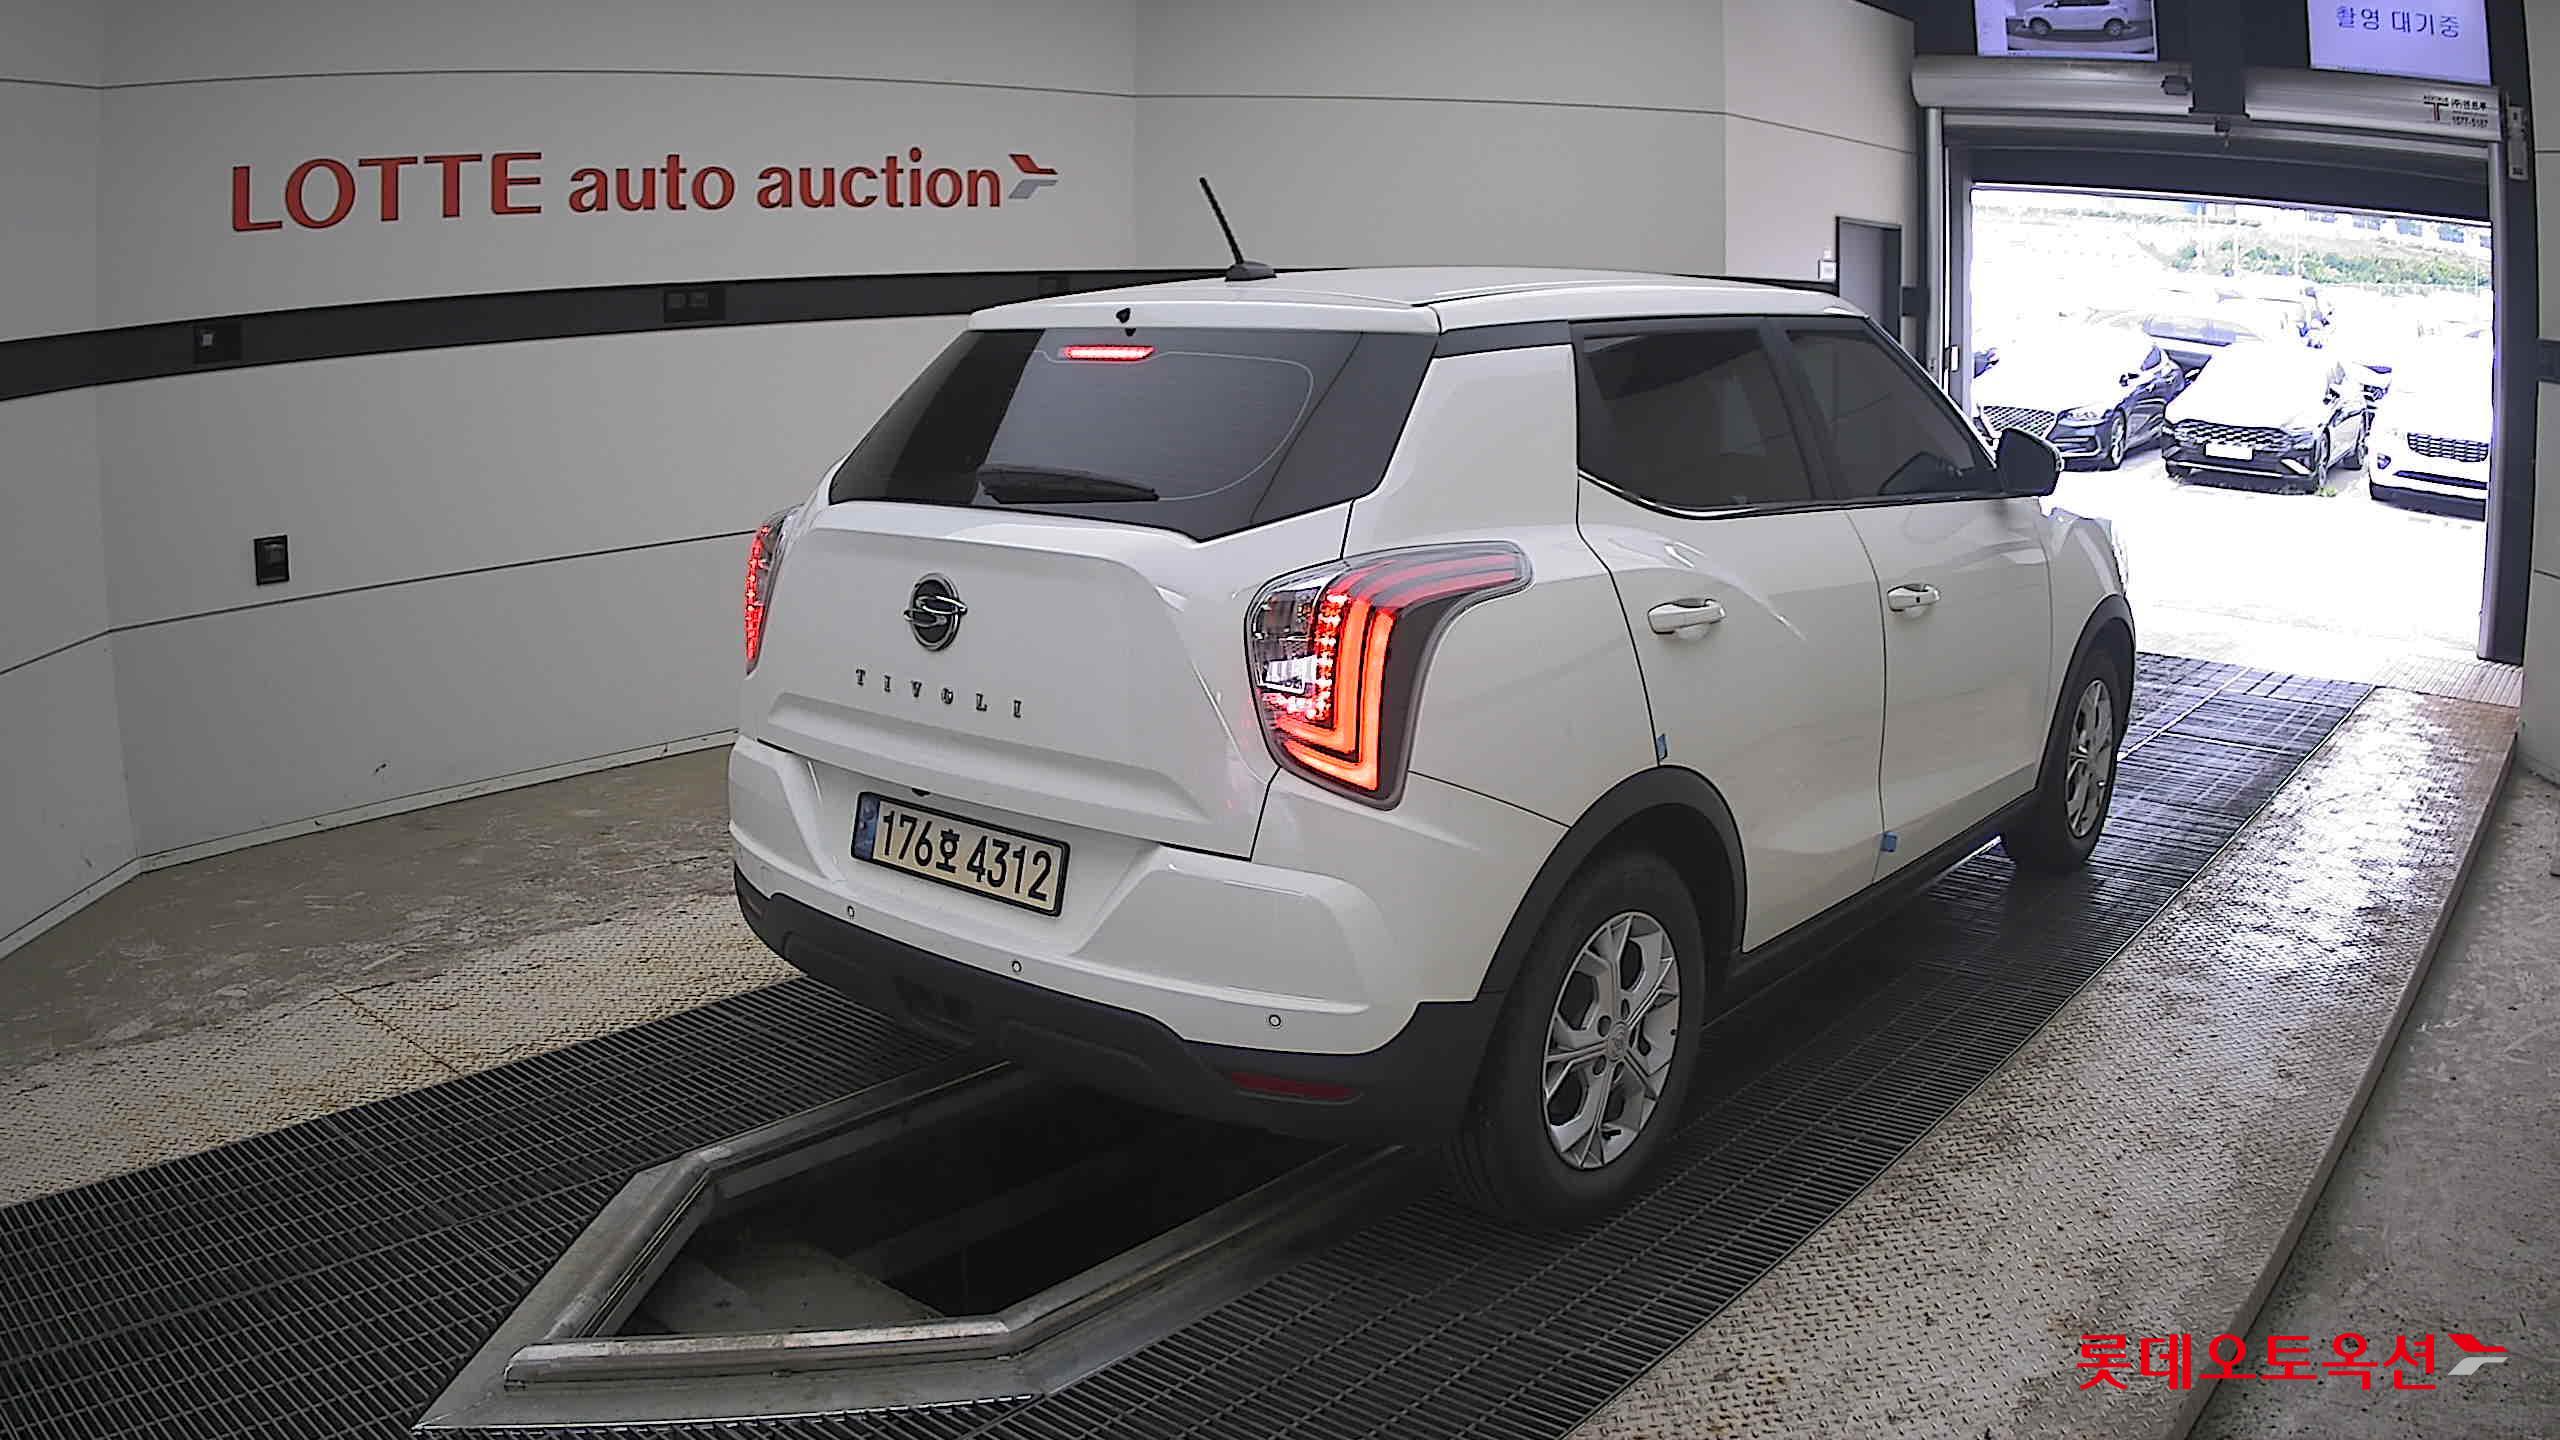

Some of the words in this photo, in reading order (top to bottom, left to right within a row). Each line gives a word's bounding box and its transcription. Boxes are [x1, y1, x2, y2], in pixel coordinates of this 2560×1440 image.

[2337, 5, 2380, 31] 촬영
[2391, 11, 2460, 38] 대기중
[232, 152, 542, 232] LOTTE
[569, 153, 735, 213] auto
[757, 147, 1001, 208] auction
[855, 668, 1022, 719] TIVOLI
[883, 810, 961, 874] 176호
[966, 835, 1051, 902] 4312
